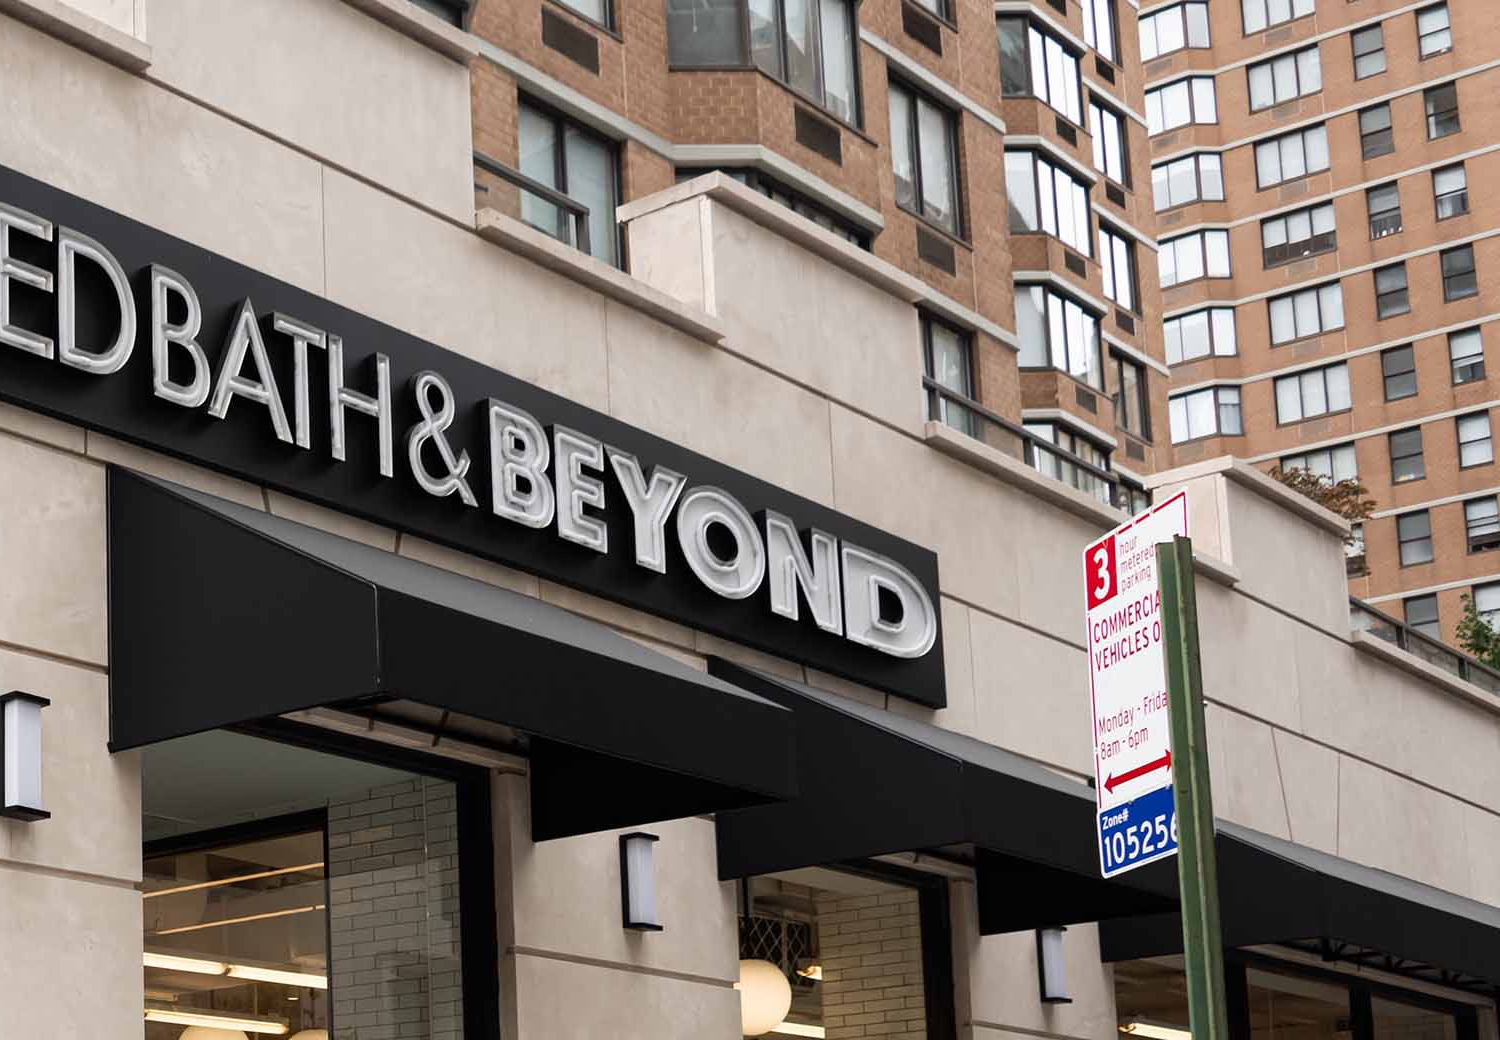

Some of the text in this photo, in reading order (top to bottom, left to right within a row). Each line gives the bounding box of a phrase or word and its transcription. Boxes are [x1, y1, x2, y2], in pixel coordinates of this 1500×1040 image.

[150, 264, 394, 477] BATH
[407, 370, 476, 508] &
[489, 398, 937, 660] BEYOND
[1093, 547, 1111, 600] 3
[1121, 544, 1155, 574] metered
[1121, 565, 1152, 595] parking
[1094, 590, 1161, 643] COMMERCIA
[1095, 629, 1151, 672] VEHICLES
[1099, 706, 1134, 736] Monday
[1144, 690, 1168, 716] Frida
[1100, 739, 1121, 760] 8am
[1128, 725, 1149, 751] 6pm
[1102, 808, 1130, 831] Zone#
